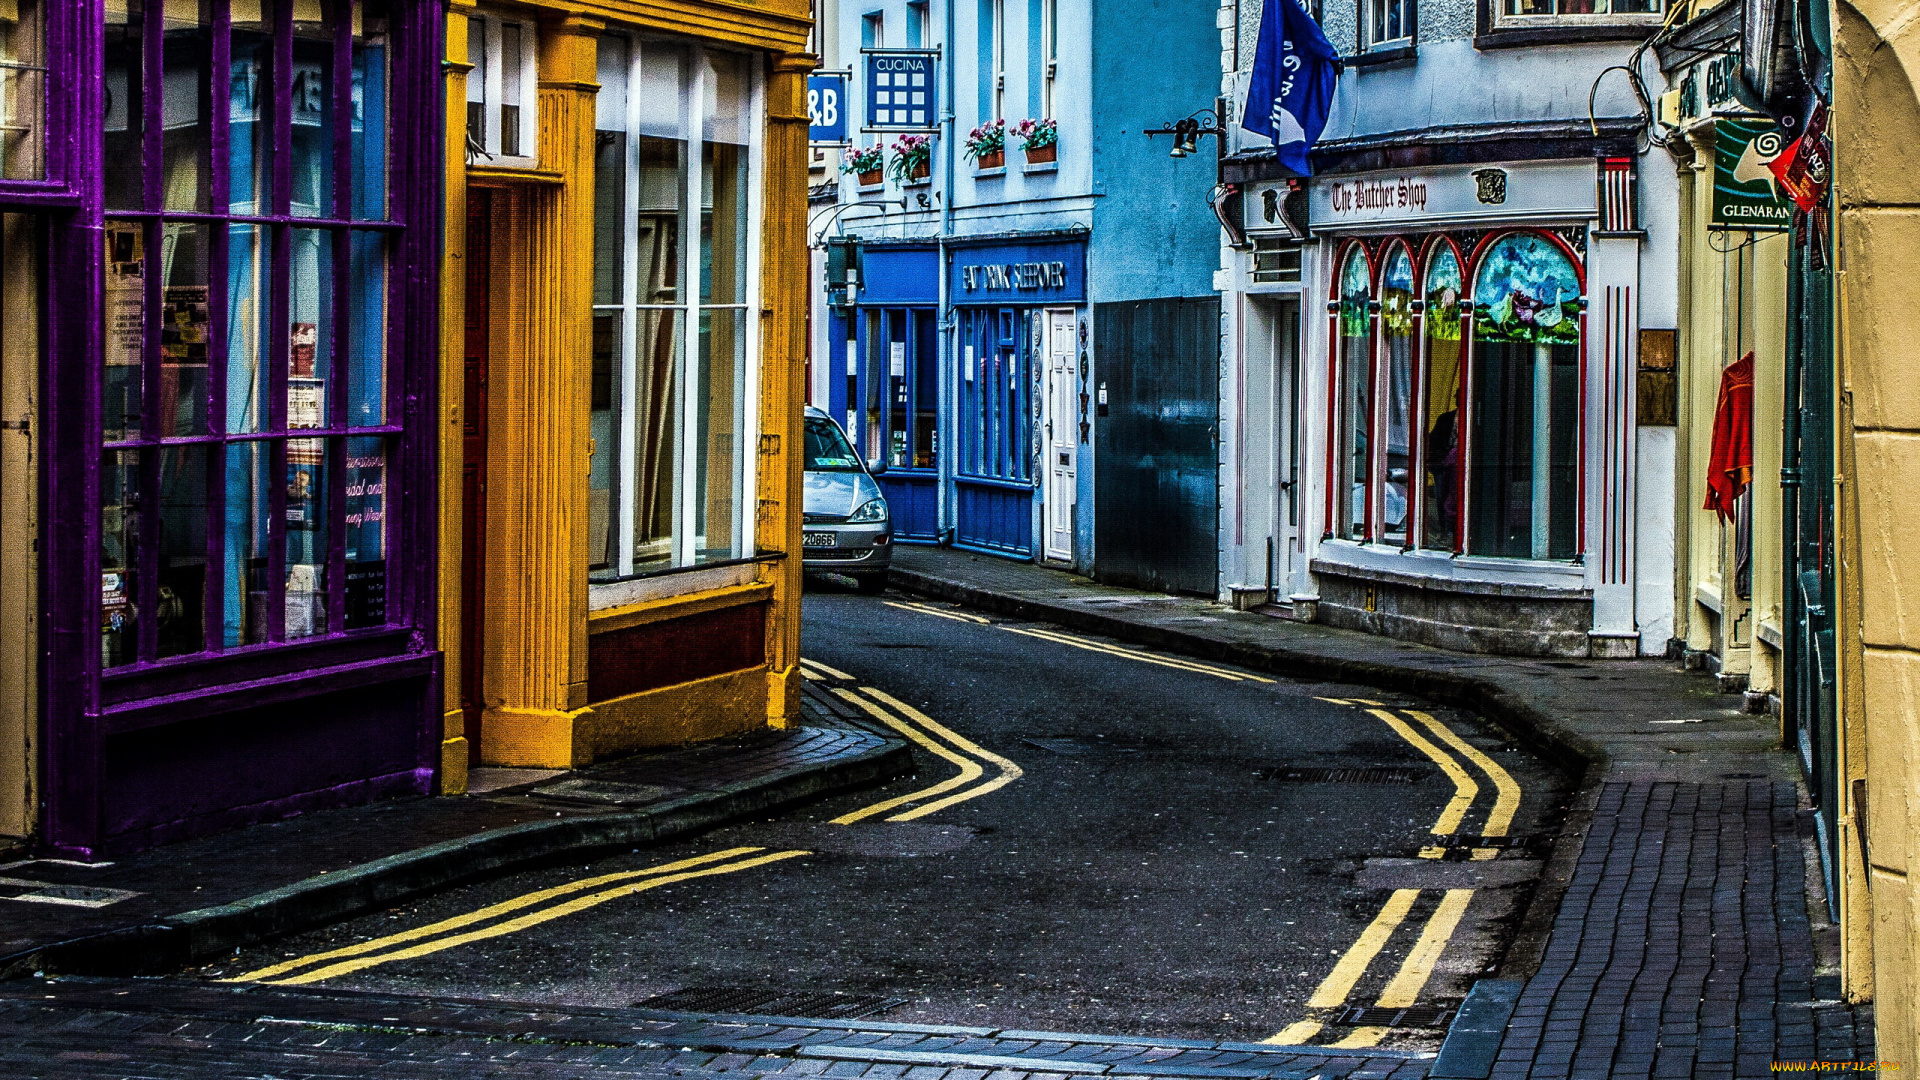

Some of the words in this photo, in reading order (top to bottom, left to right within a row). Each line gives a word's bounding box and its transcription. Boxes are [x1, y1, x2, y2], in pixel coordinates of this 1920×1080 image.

[876, 59, 925, 71] CUCINA
[1332, 182, 1352, 217] The
[1354, 180, 1395, 214] Butcher
[1398, 176, 1427, 212] Shop
[963, 265, 979, 289] EAT
[984, 264, 1011, 289] DRINK
[1015, 261, 1064, 288] SLEEPOVER
[804, 534, 832, 545] 20866
